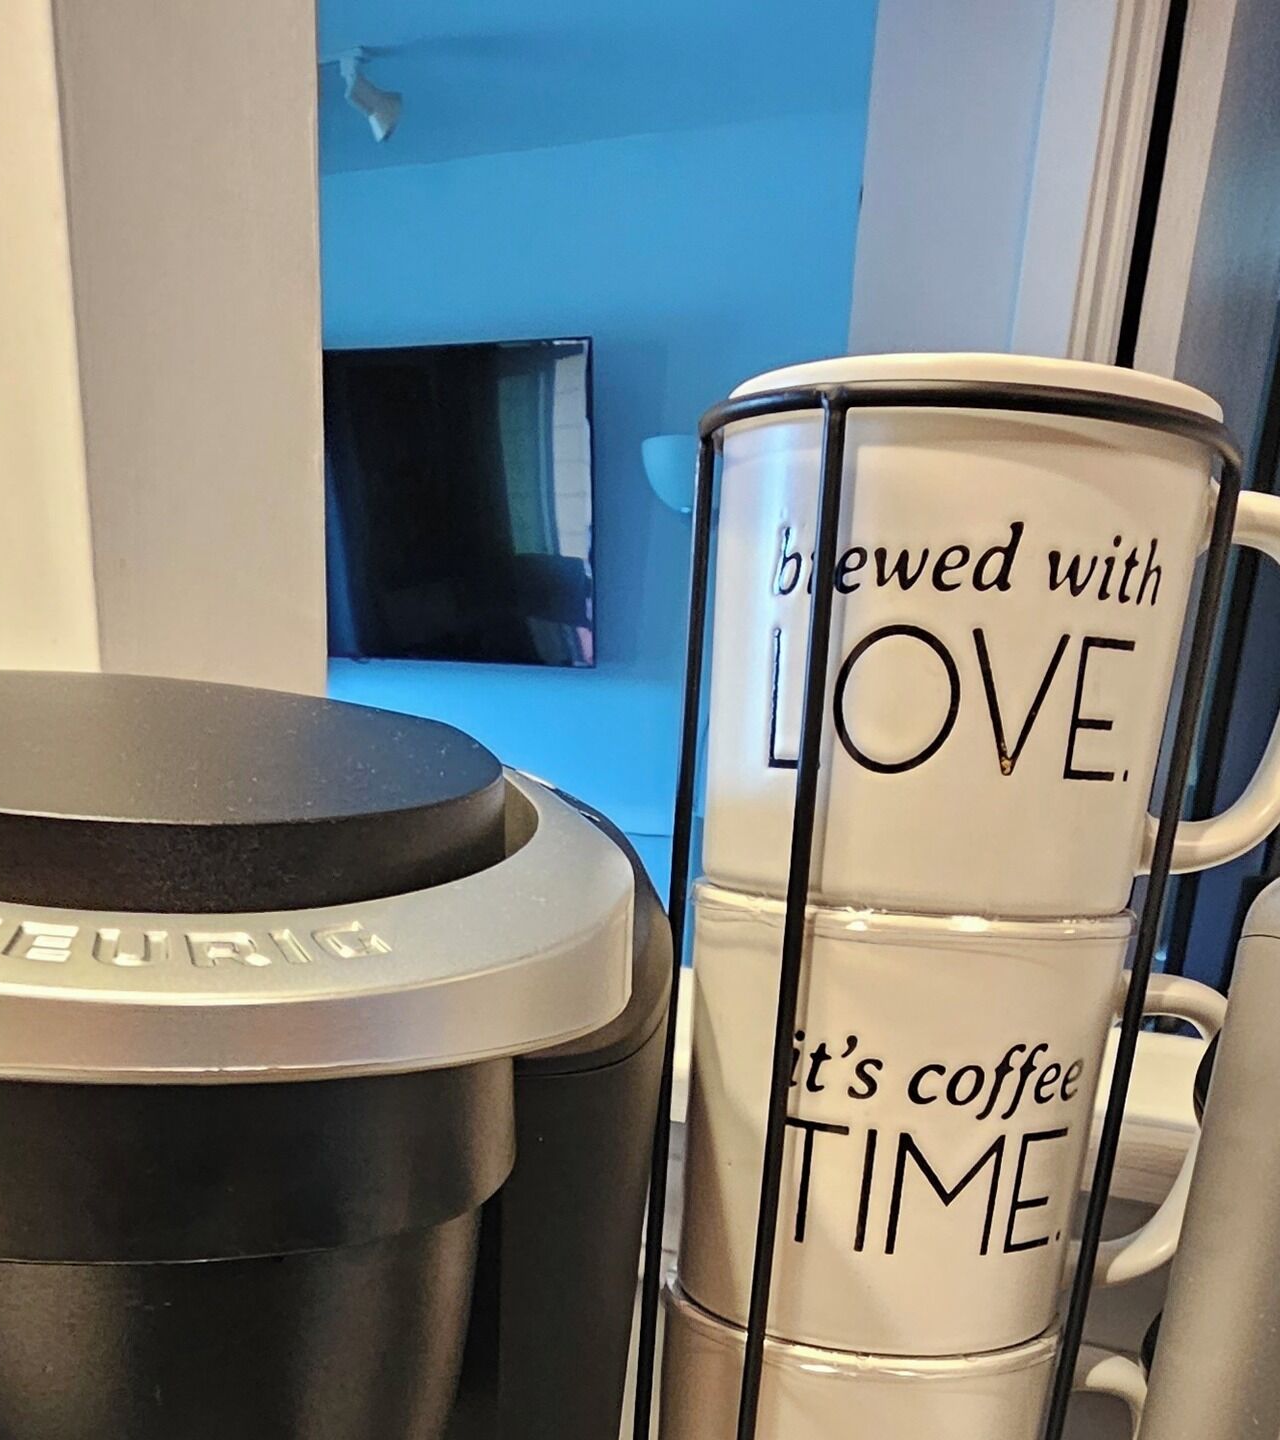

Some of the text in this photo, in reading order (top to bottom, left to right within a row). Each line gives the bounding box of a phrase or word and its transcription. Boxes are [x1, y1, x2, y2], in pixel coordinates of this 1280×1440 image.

[1047, 535, 1163, 606] with
[767, 624, 1136, 781] LOVE.
[907, 1042, 1085, 1120] coffee
[783, 1116, 1070, 1256] TIME.
